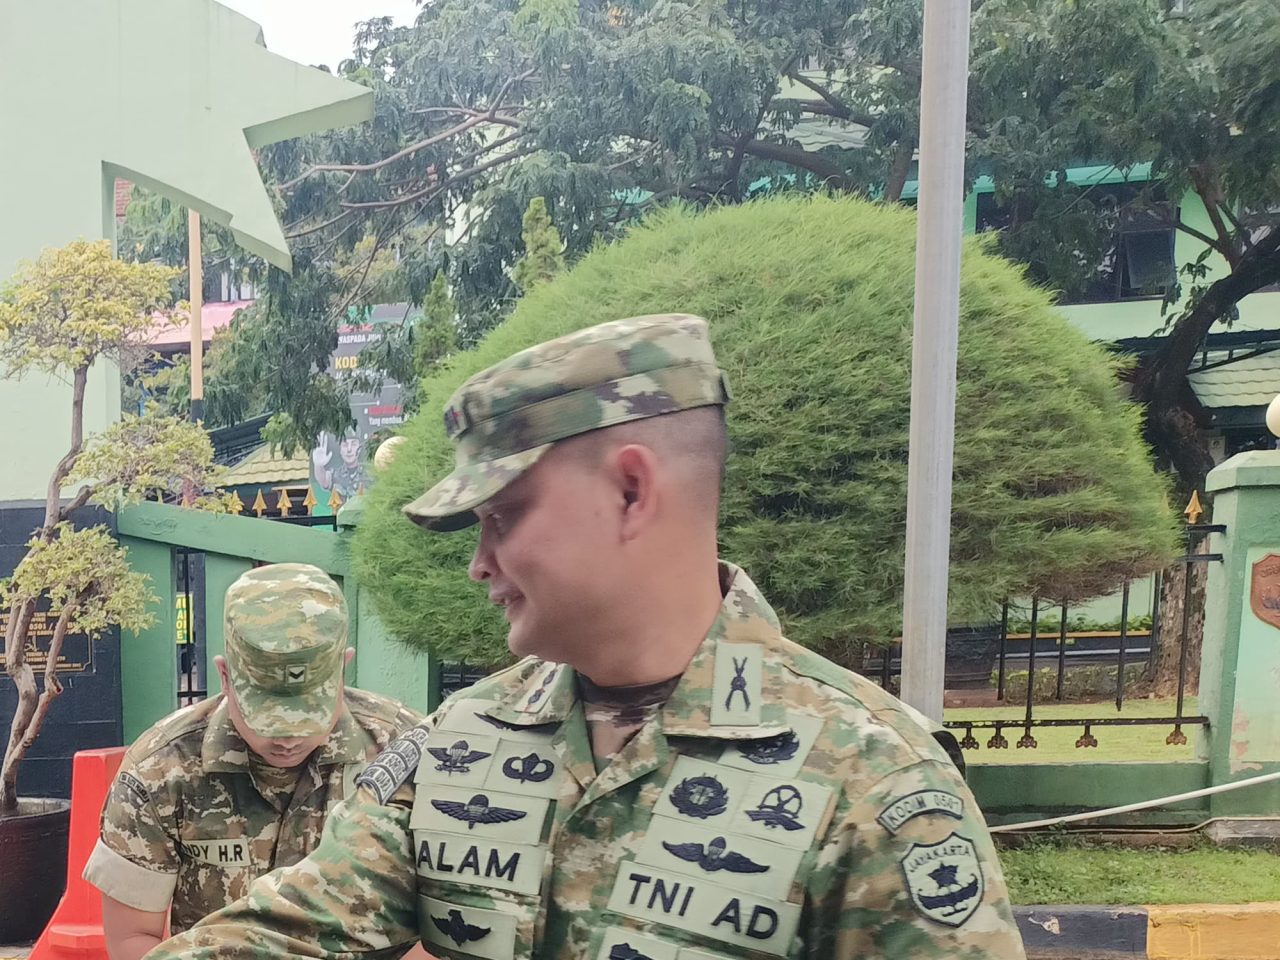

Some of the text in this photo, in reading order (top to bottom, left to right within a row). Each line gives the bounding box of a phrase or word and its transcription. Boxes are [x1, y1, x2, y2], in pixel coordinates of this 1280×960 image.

[181, 843, 244, 862] NDY H.R
[417, 840, 521, 882] ALAM
[629, 873, 779, 941] TNI AD
